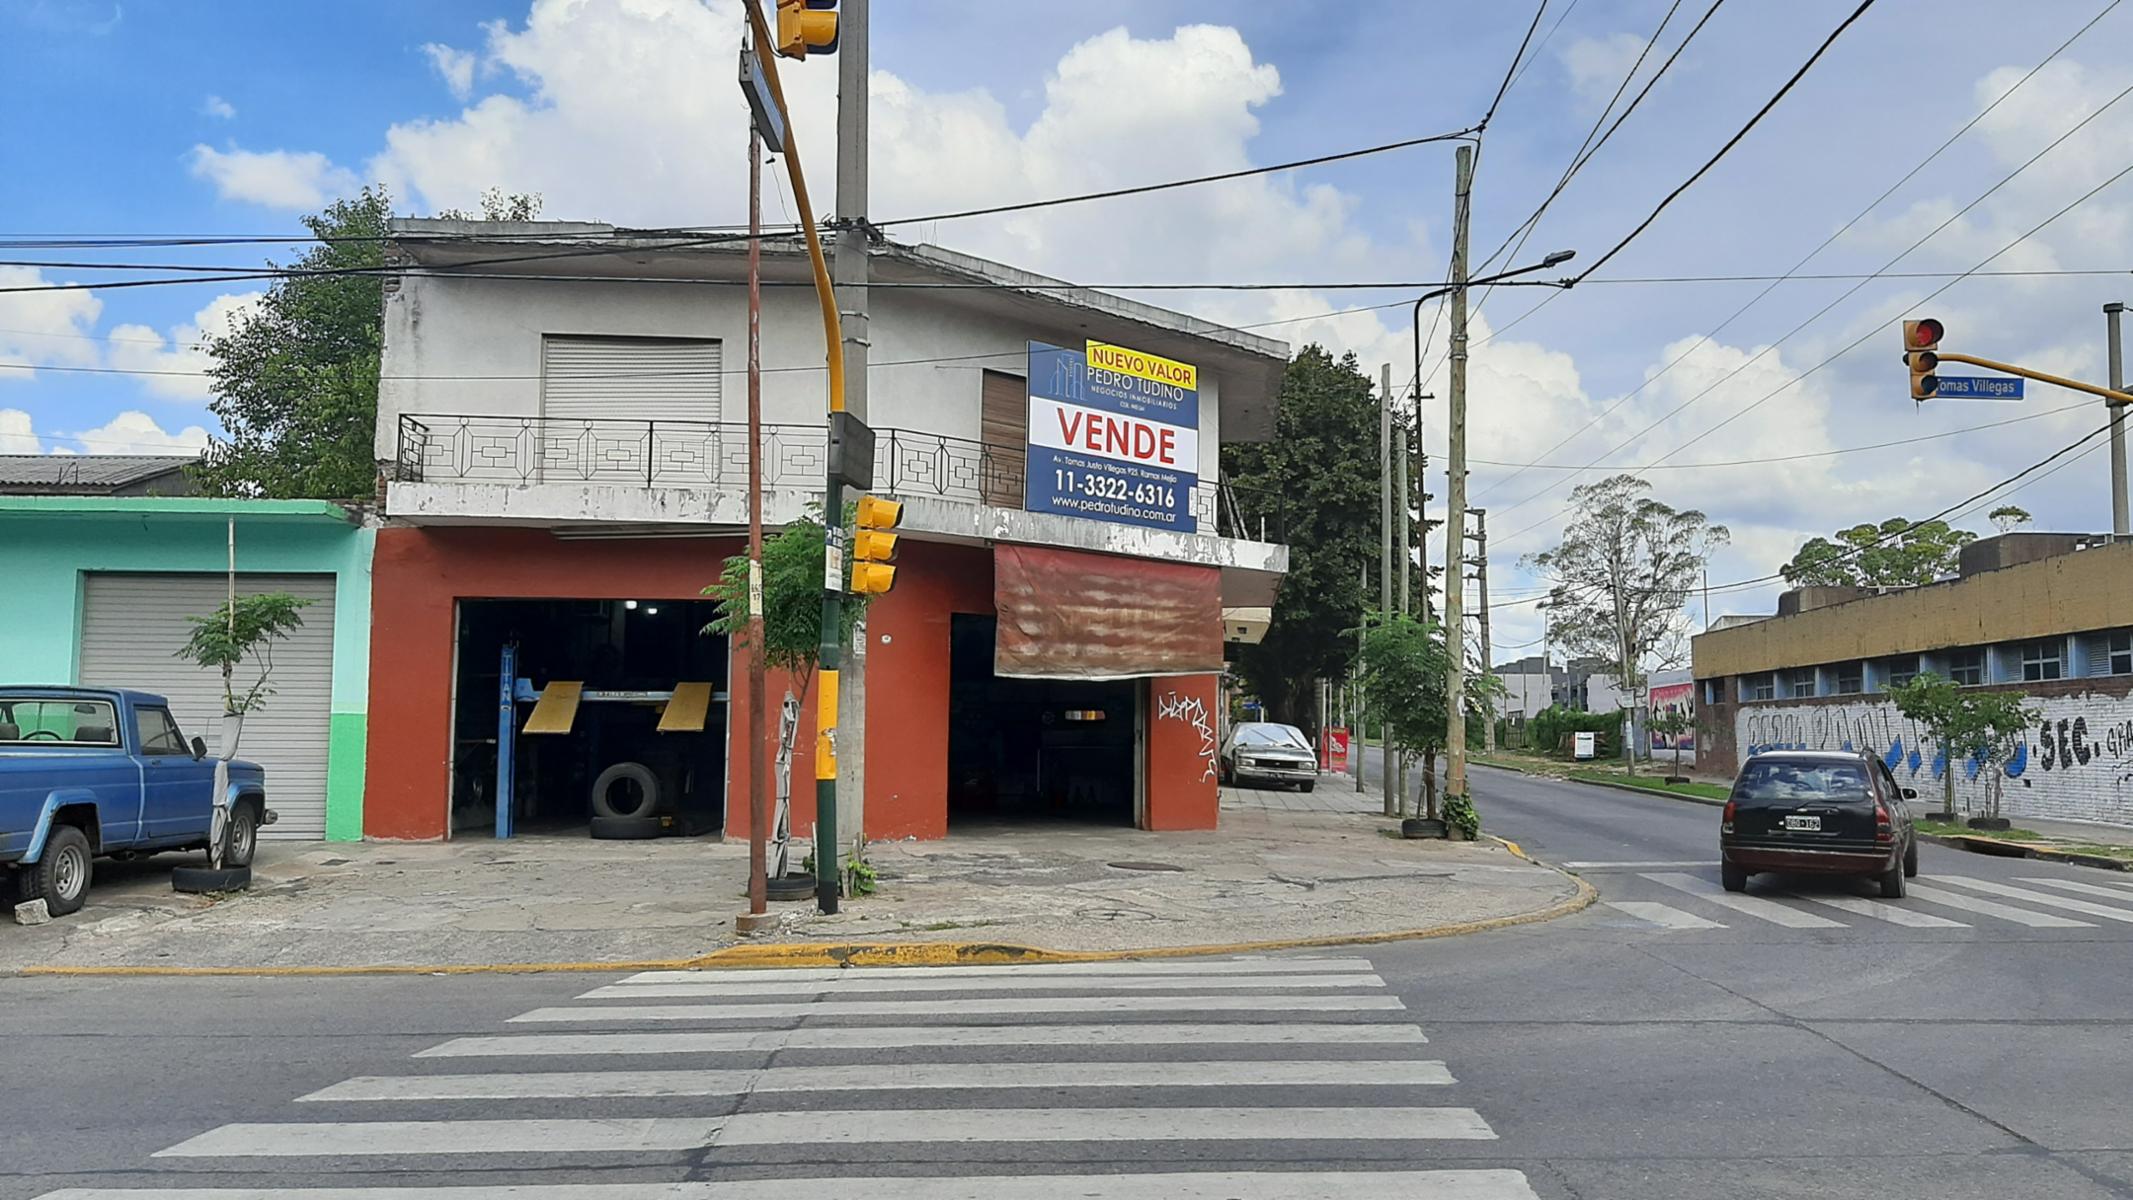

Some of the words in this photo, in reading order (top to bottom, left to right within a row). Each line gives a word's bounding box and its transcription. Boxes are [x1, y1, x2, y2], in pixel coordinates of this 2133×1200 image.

[1093, 348, 1144, 372] NUEVO
[1148, 361, 1191, 384] VALOR
[1087, 366, 1133, 390] PEDRO
[1137, 378, 1184, 402] TUDINO
[1091, 385, 1127, 399] NEGOCIOS
[1129, 394, 1177, 410] INMOBILIARIOS
[1936, 379, 1969, 392] omas
[1972, 379, 2015, 395] Villegas
[1057, 407, 1175, 465] VENDE
[1086, 461, 1103, 471] Justo
[1103, 463, 1127, 475] Villegas
[1055, 469, 1175, 508] 11-3322-6316
[1052, 496, 1176, 523] www.pedrotudino.com.ar
